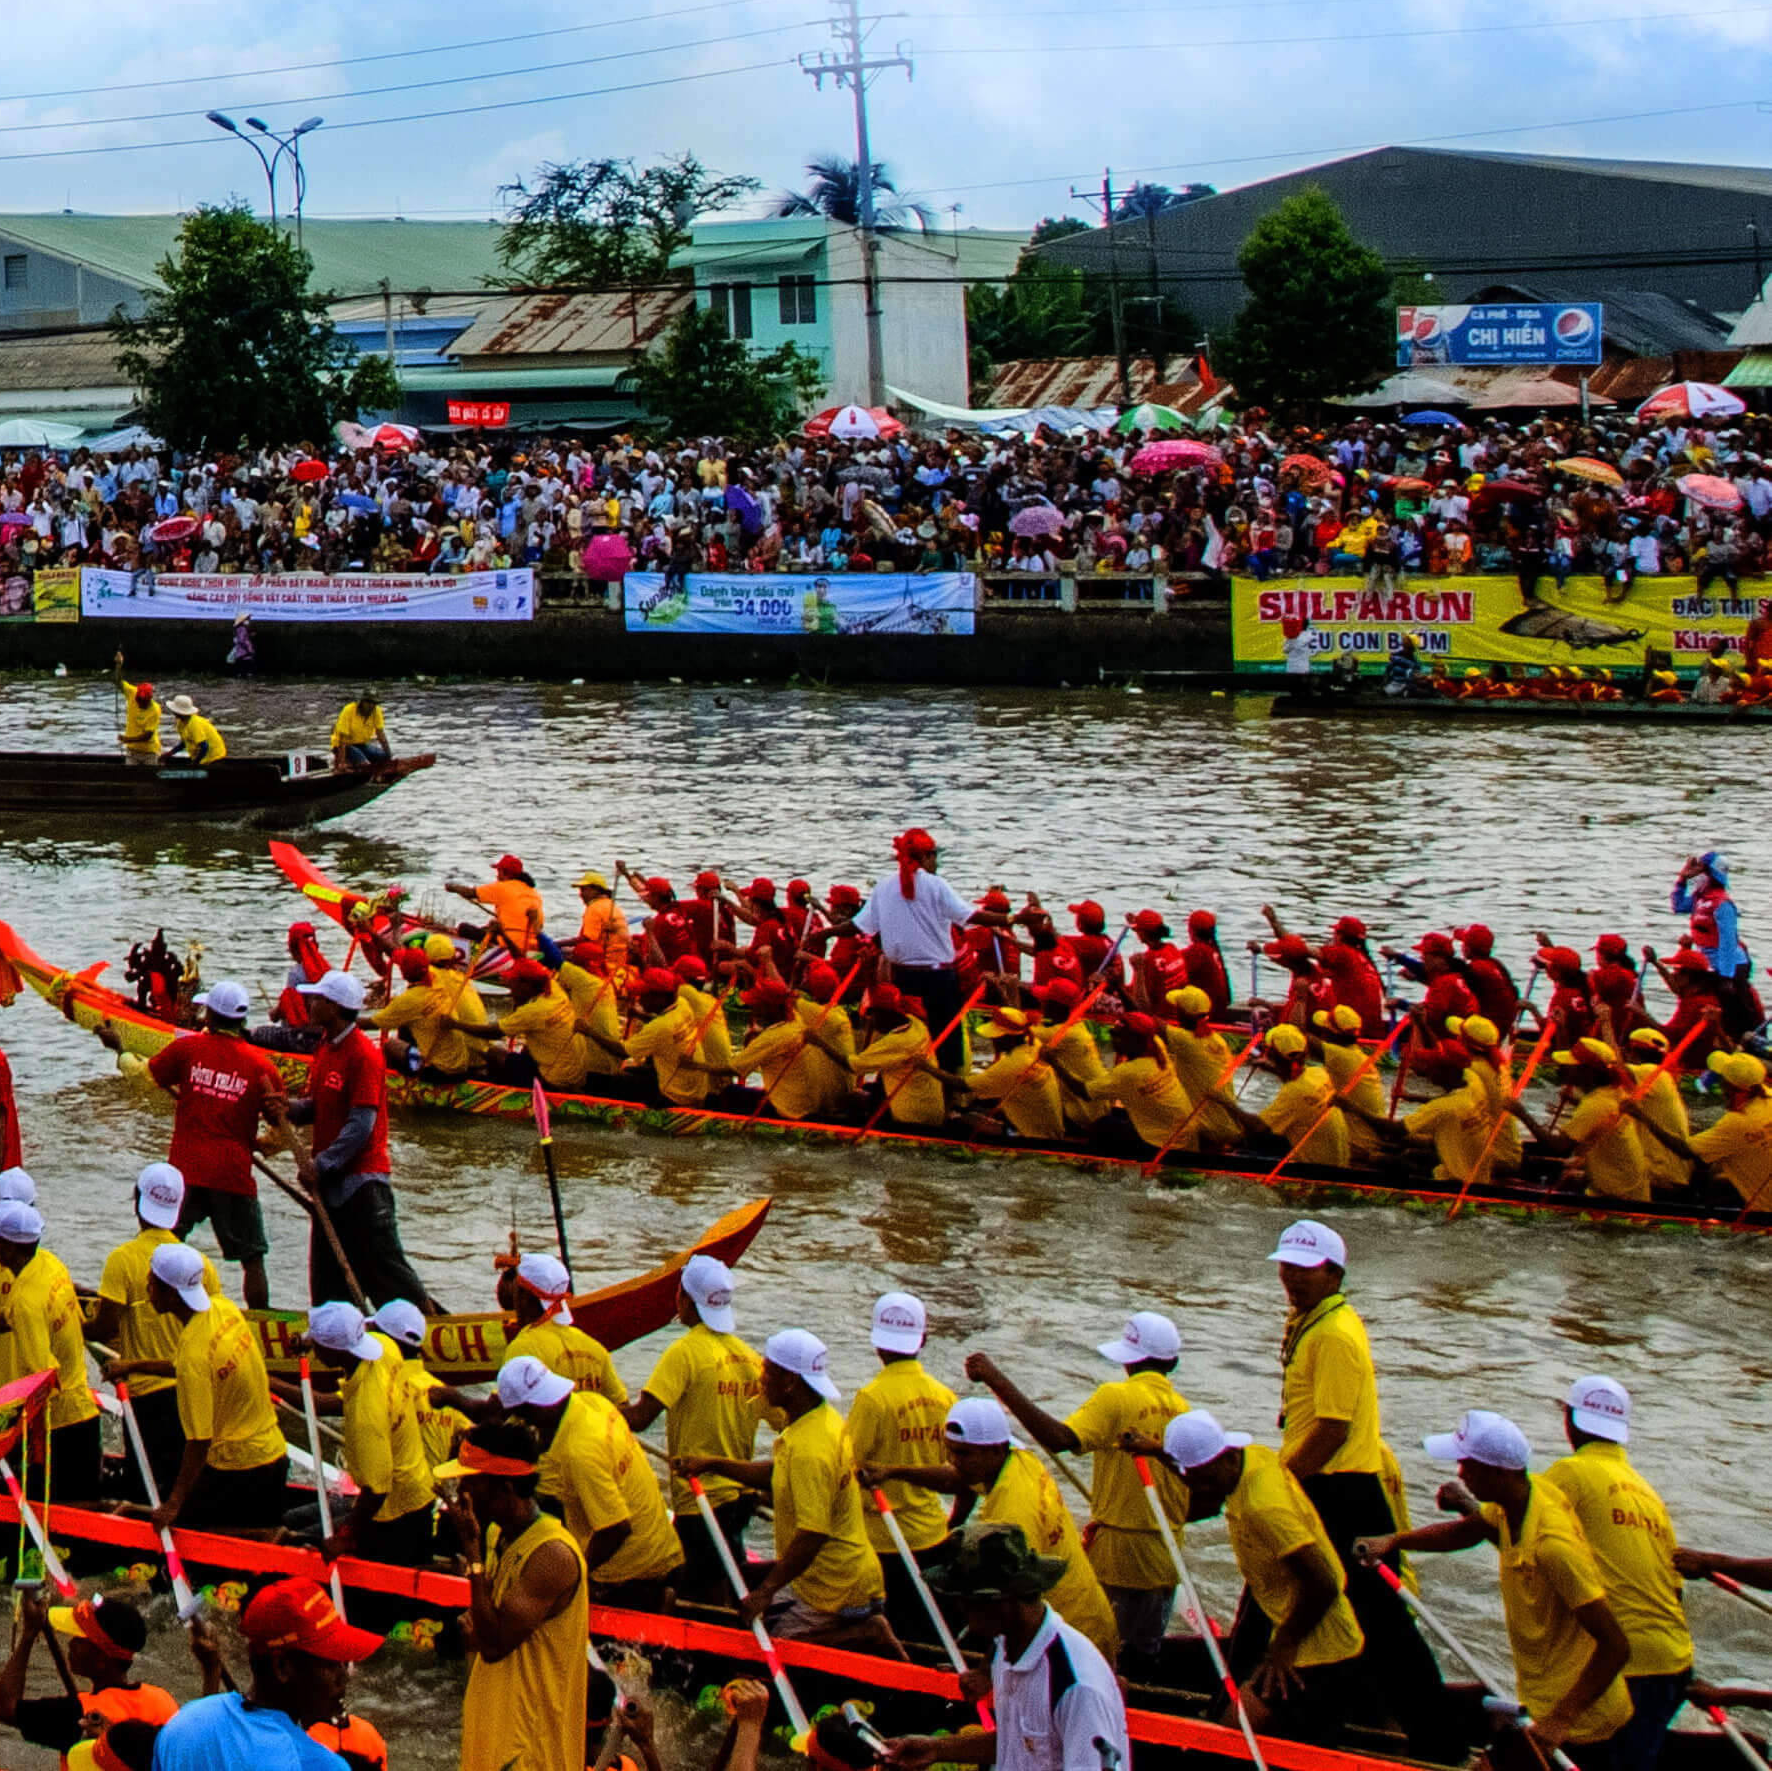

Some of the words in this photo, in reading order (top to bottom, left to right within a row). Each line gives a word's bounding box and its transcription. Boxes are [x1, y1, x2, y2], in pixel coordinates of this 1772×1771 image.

[1468, 327, 1498, 350] CHỊ
[733, 599, 792, 616] 34.000
[1259, 591, 1474, 622] SULFARON
[1338, 632, 1379, 651] CON
